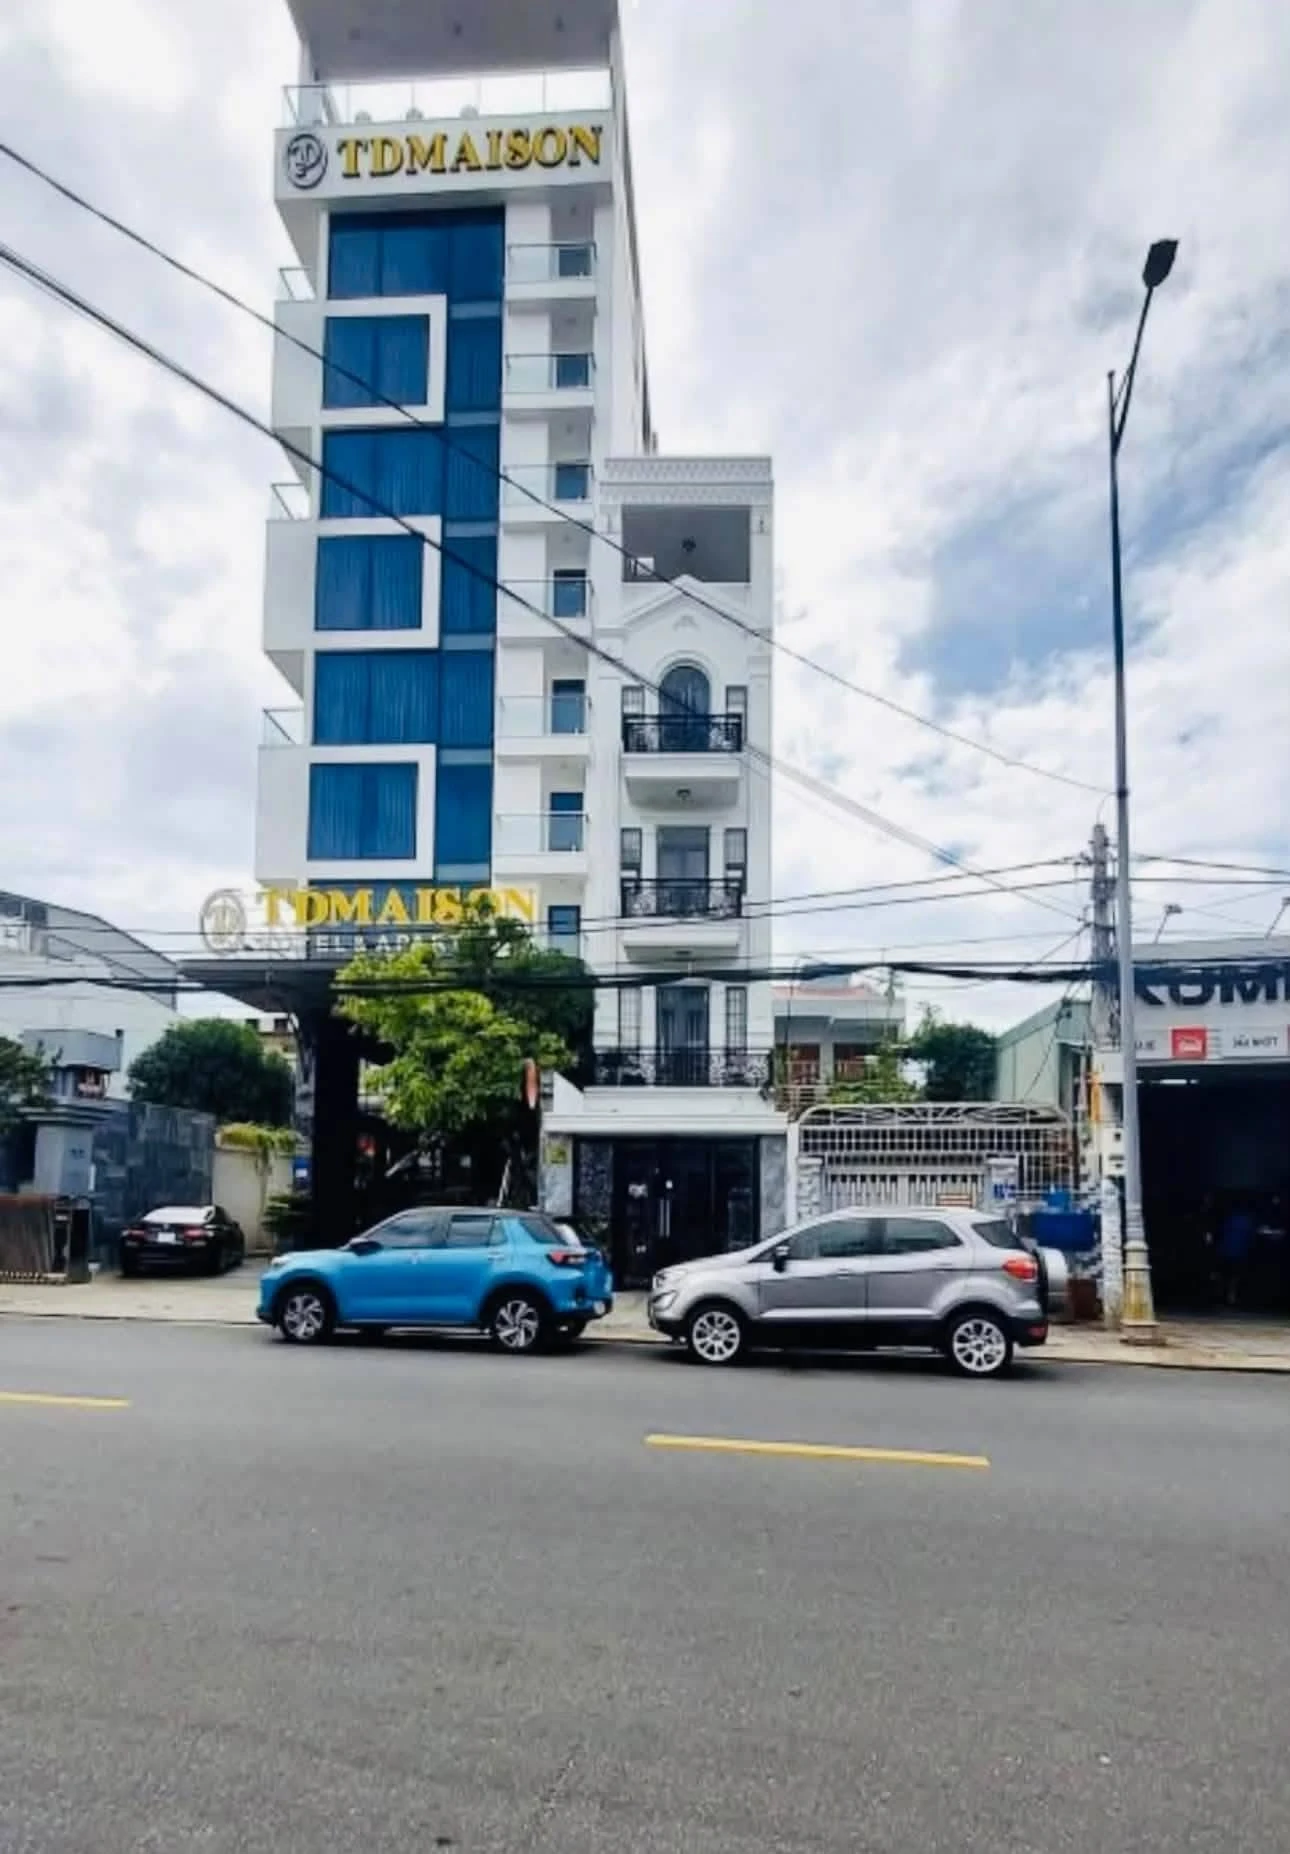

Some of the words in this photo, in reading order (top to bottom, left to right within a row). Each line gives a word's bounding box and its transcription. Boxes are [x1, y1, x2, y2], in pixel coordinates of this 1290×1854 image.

[336, 125, 603, 179] TDMAISON
[256, 886, 538, 927] TDMAISON
[1133, 965, 1290, 1005] UM
